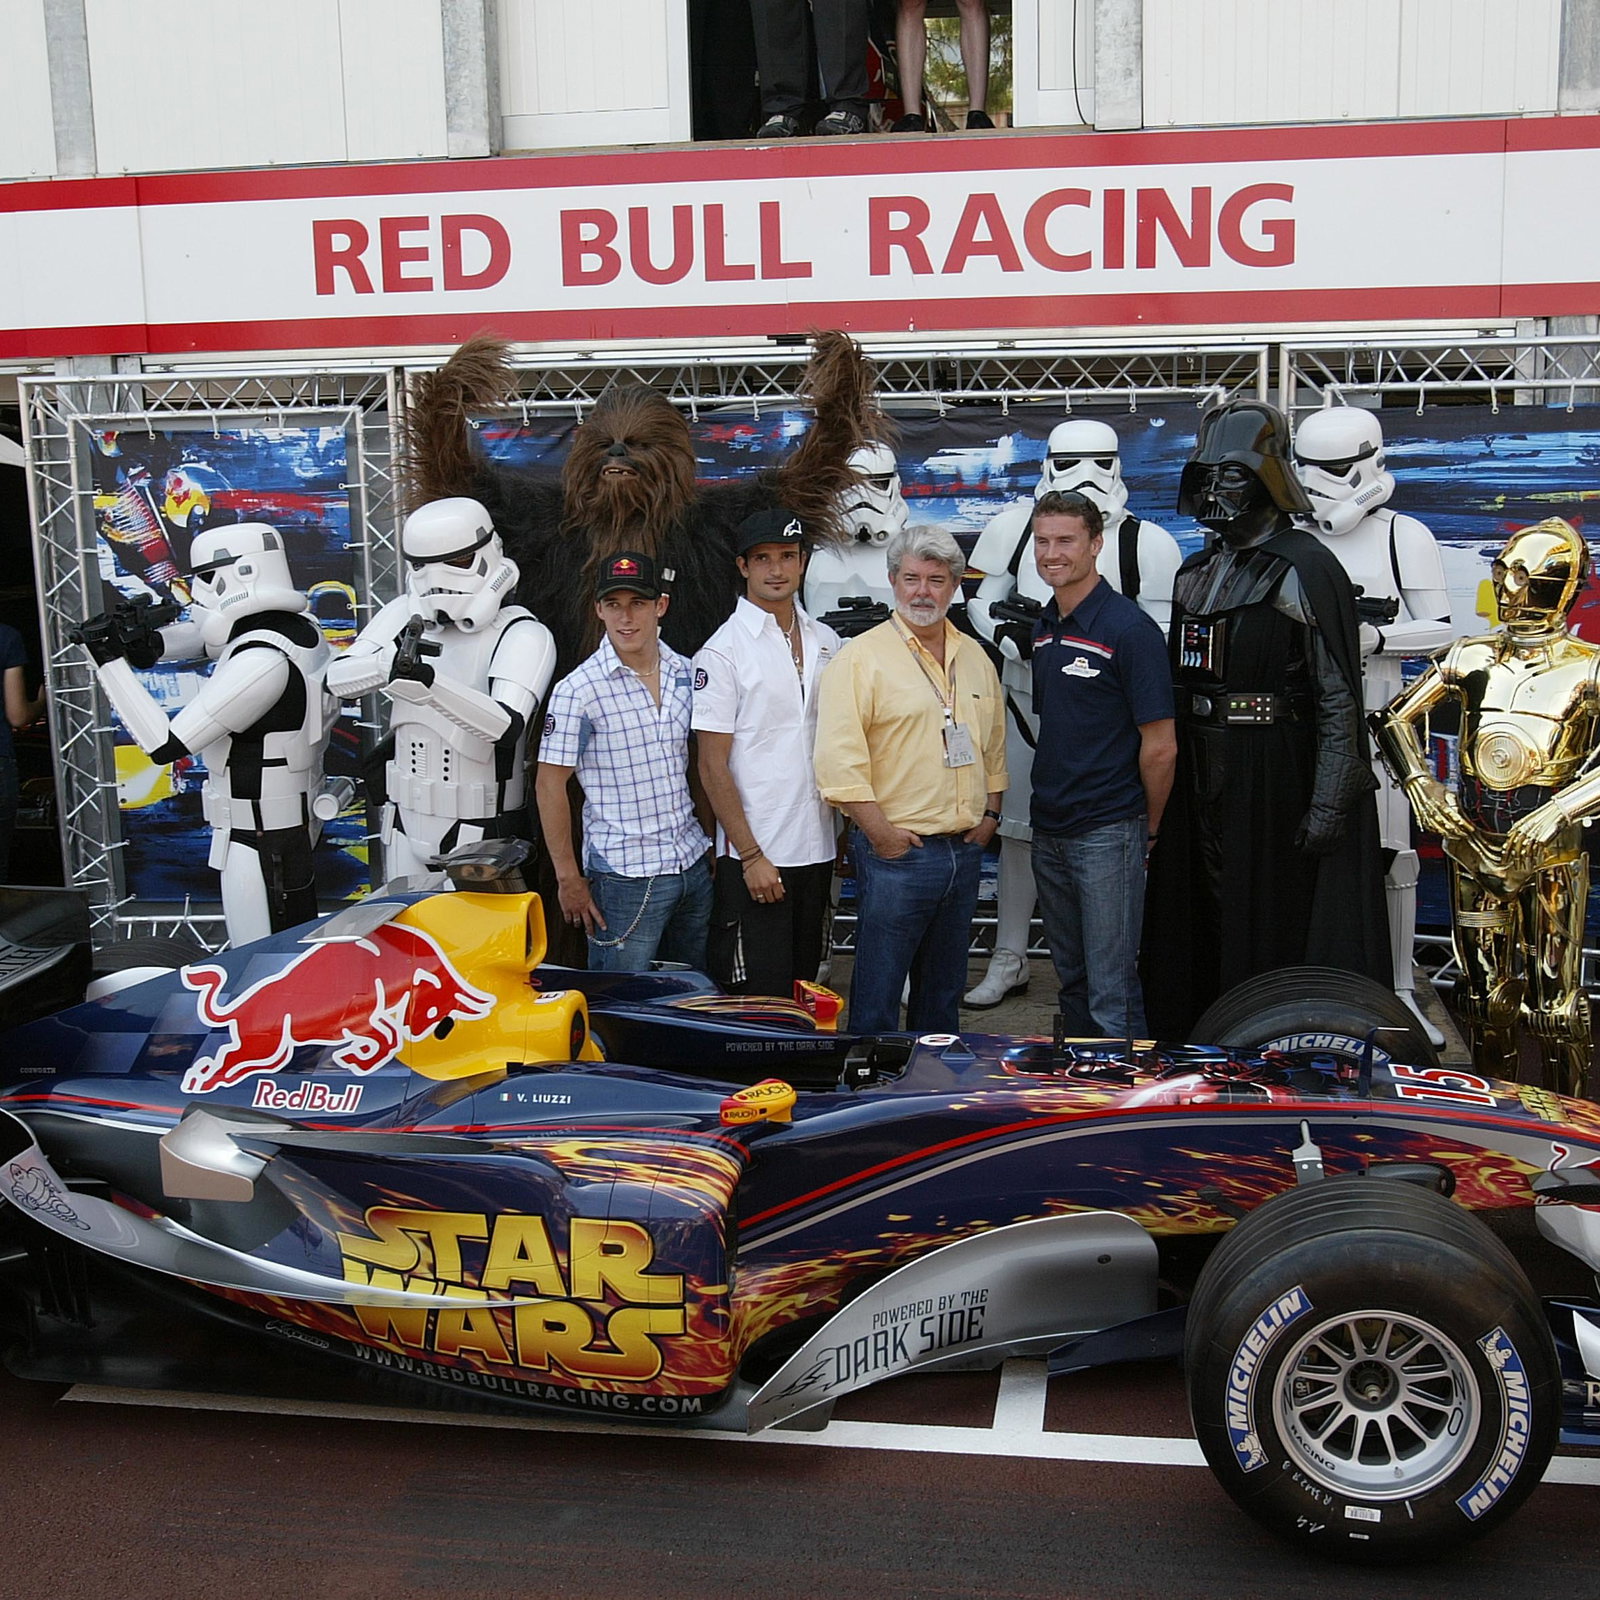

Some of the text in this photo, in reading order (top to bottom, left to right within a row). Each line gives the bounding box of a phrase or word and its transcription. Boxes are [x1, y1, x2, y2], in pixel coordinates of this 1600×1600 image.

[312, 182, 1296, 295] RED BULL RACING
[726, 1042, 762, 1052] POWERED
[765, 1042, 775, 1051] BY
[777, 1042, 795, 1051] THE
[818, 1041, 835, 1050] SIDE
[517, 1093, 572, 1104] V. LIUZZI
[745, 1083, 790, 1098] RAUCH
[1388, 1064, 1497, 1107] 15
[336, 1205, 685, 1303] STAR
[343, 1256, 687, 1382] WARS
[873, 1288, 989, 1330] POWERED BY THE
[352, 1342, 703, 1413] WWW.REDBULLRACING.COM
[822, 1305, 986, 1392] DARK SIDE
[1229, 1289, 1302, 1431] MICHELIN
[1290, 1425, 1337, 1471] RACING
[1467, 1370, 1529, 1517] MICHELIN
